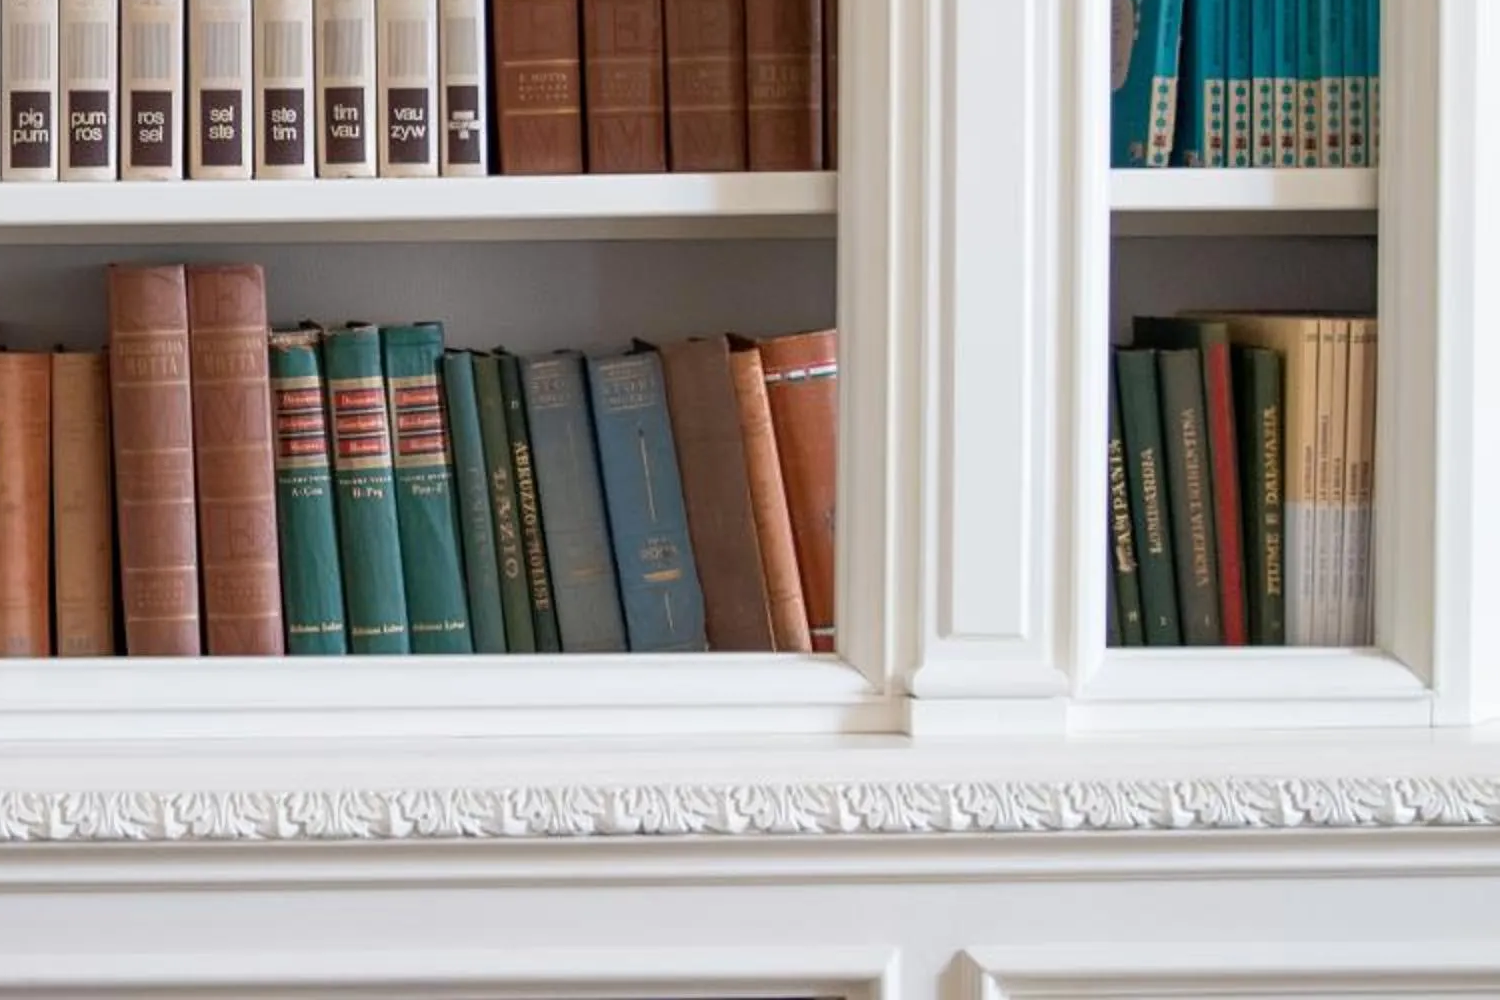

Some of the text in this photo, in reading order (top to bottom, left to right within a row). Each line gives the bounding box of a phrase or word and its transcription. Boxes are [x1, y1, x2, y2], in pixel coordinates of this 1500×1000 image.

[19, 109, 43, 128] pig
[71, 110, 105, 128] pum
[138, 112, 164, 126] ros
[210, 106, 233, 122] sel
[271, 107, 296, 122] ste
[333, 105, 358, 122] tim
[394, 108, 423, 121] vau
[13, 127, 48, 144] pum
[75, 126, 102, 142] ros
[139, 126, 163, 142] sel
[209, 124, 234, 139] ste
[272, 123, 297, 141] tim
[331, 124, 359, 138] vau
[391, 124, 425, 140] zyw
[1140, 447, 1163, 554] LOMBARDIA
